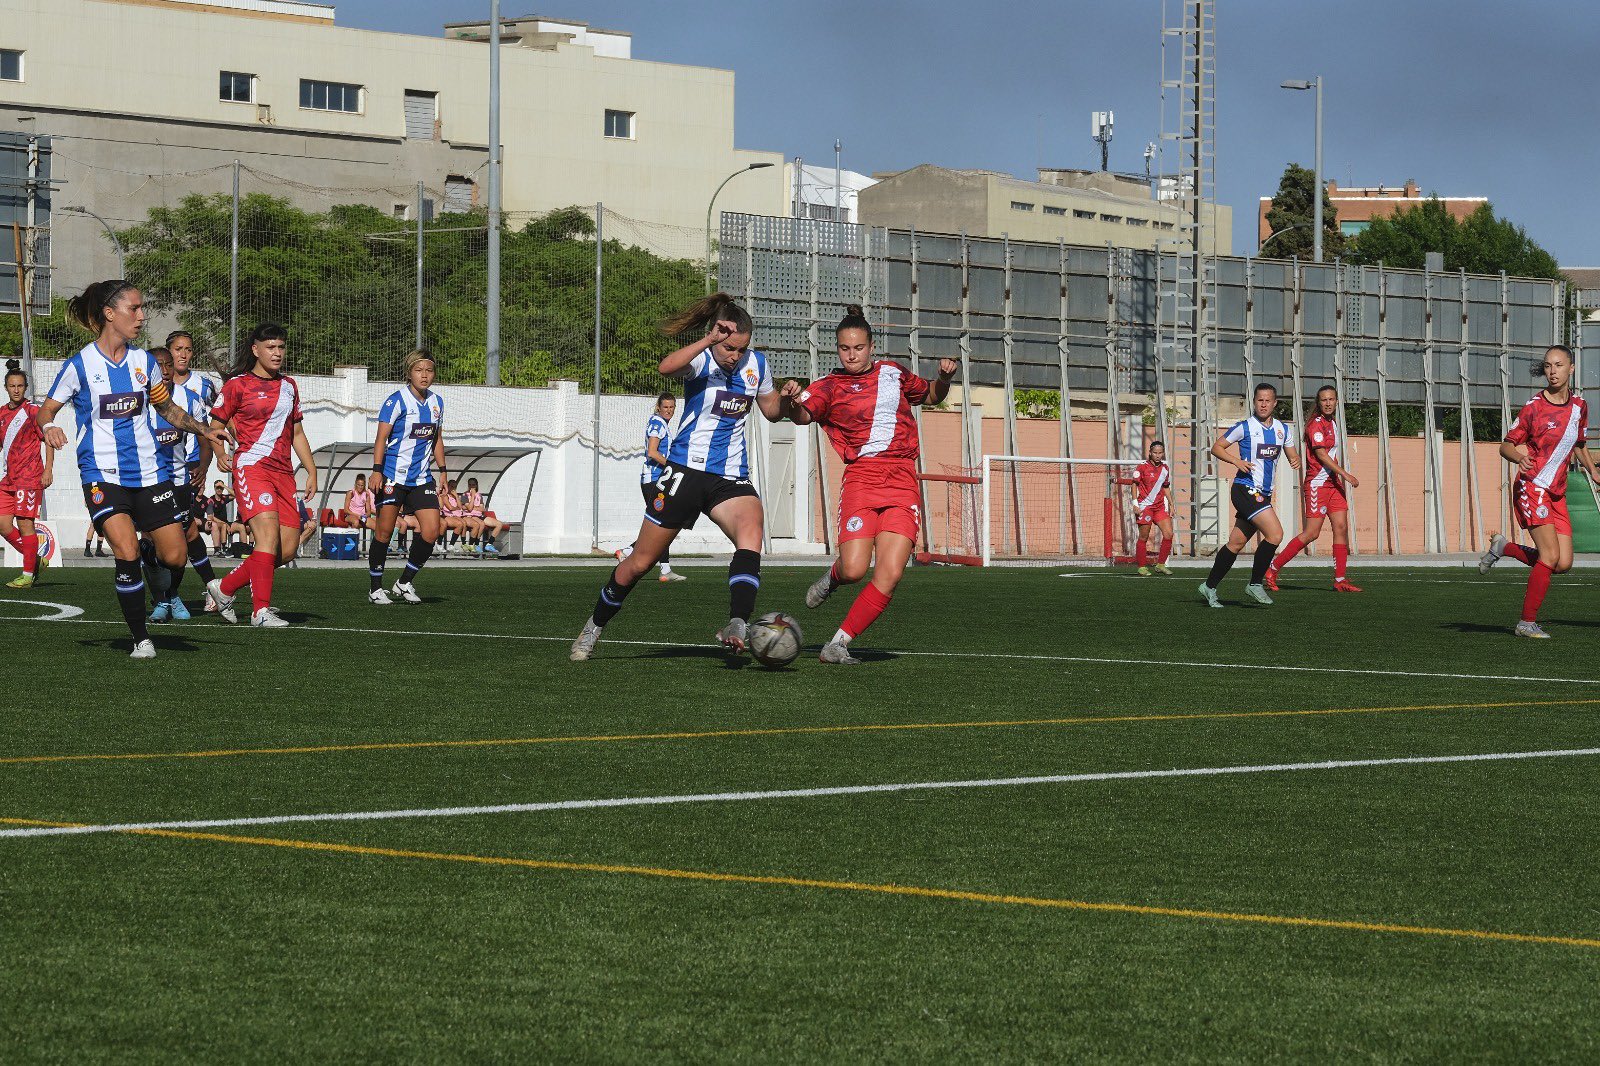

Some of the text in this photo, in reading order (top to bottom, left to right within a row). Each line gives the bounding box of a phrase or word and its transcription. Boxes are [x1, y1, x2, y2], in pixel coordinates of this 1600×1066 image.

[656, 466, 684, 497] 21
[17, 490, 25, 503] 9
[1533, 488, 1544, 504] 7
